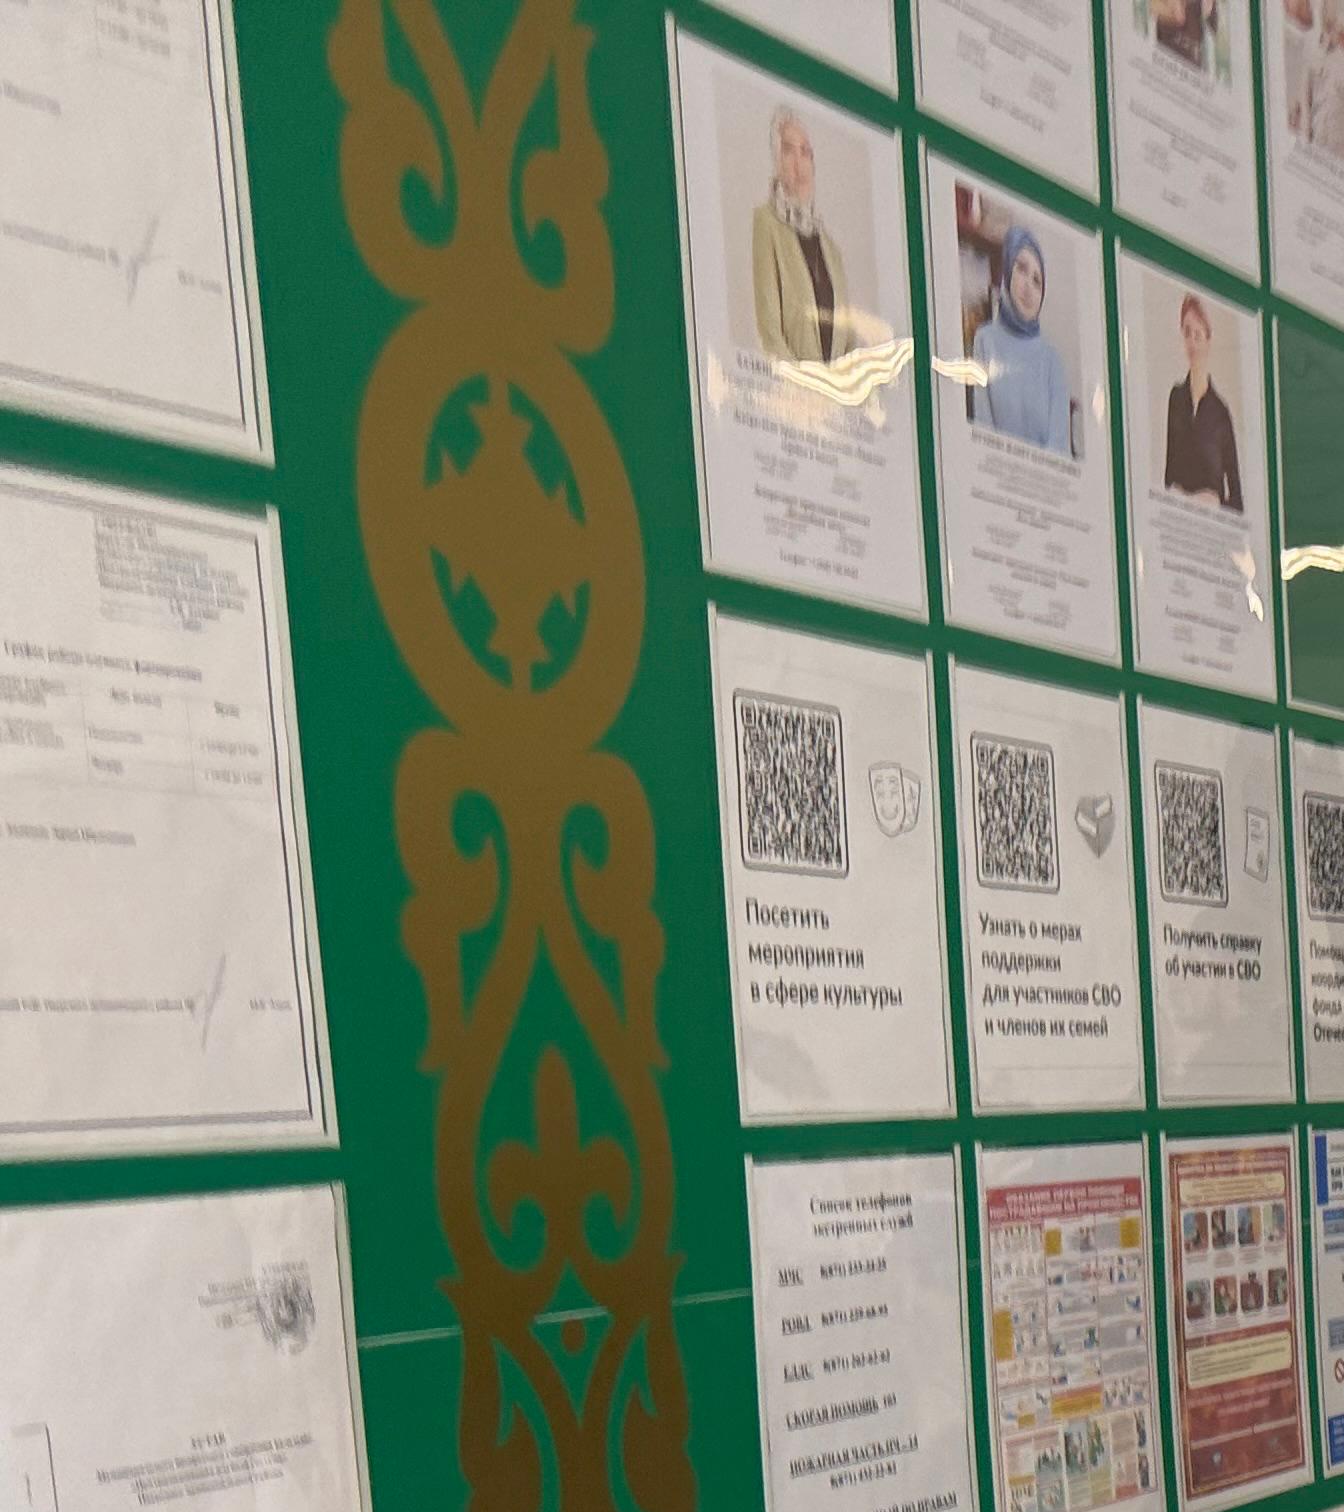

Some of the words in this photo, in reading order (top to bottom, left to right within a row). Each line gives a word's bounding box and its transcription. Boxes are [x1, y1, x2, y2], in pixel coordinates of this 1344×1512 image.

[746, 896, 830, 930] Посетить
[979, 911, 1026, 939] Узнать
[1029, 920, 1038, 938] о
[1041, 922, 1082, 944] мерах
[1163, 923, 1218, 949] Получить
[1220, 932, 1262, 957] справку
[748, 943, 865, 970] мероприятия
[981, 950, 1061, 975] поддержки
[1165, 954, 1180, 976] об
[1182, 959, 1227, 980] участии
[1228, 962, 1235, 979] в
[1237, 958, 1261, 980] СВО
[750, 982, 760, 1003] в
[765, 976, 819, 1008] сфере
[823, 984, 903, 1010] культуры
[983, 983, 1010, 1006] для
[1013, 985, 1089, 1006] участников
[1092, 982, 1121, 1007] СВО
[985, 1017, 994, 1036] и
[997, 1017, 1047, 1037] членов
[1050, 1019, 1066, 1036] их
[1069, 1015, 1108, 1038] семей
[810, 1196, 853, 1216] Список
[856, 1191, 912, 1213] телефонов
[814, 1218, 877, 1240] экстренных
[786, 1408, 829, 1431] СКОРАЯ
[831, 1396, 879, 1421] ПОМОЩЬ
[790, 1449, 849, 1478] ПОЖАРНАЯ
[852, 1440, 885, 1463] ЧАСТЬ
